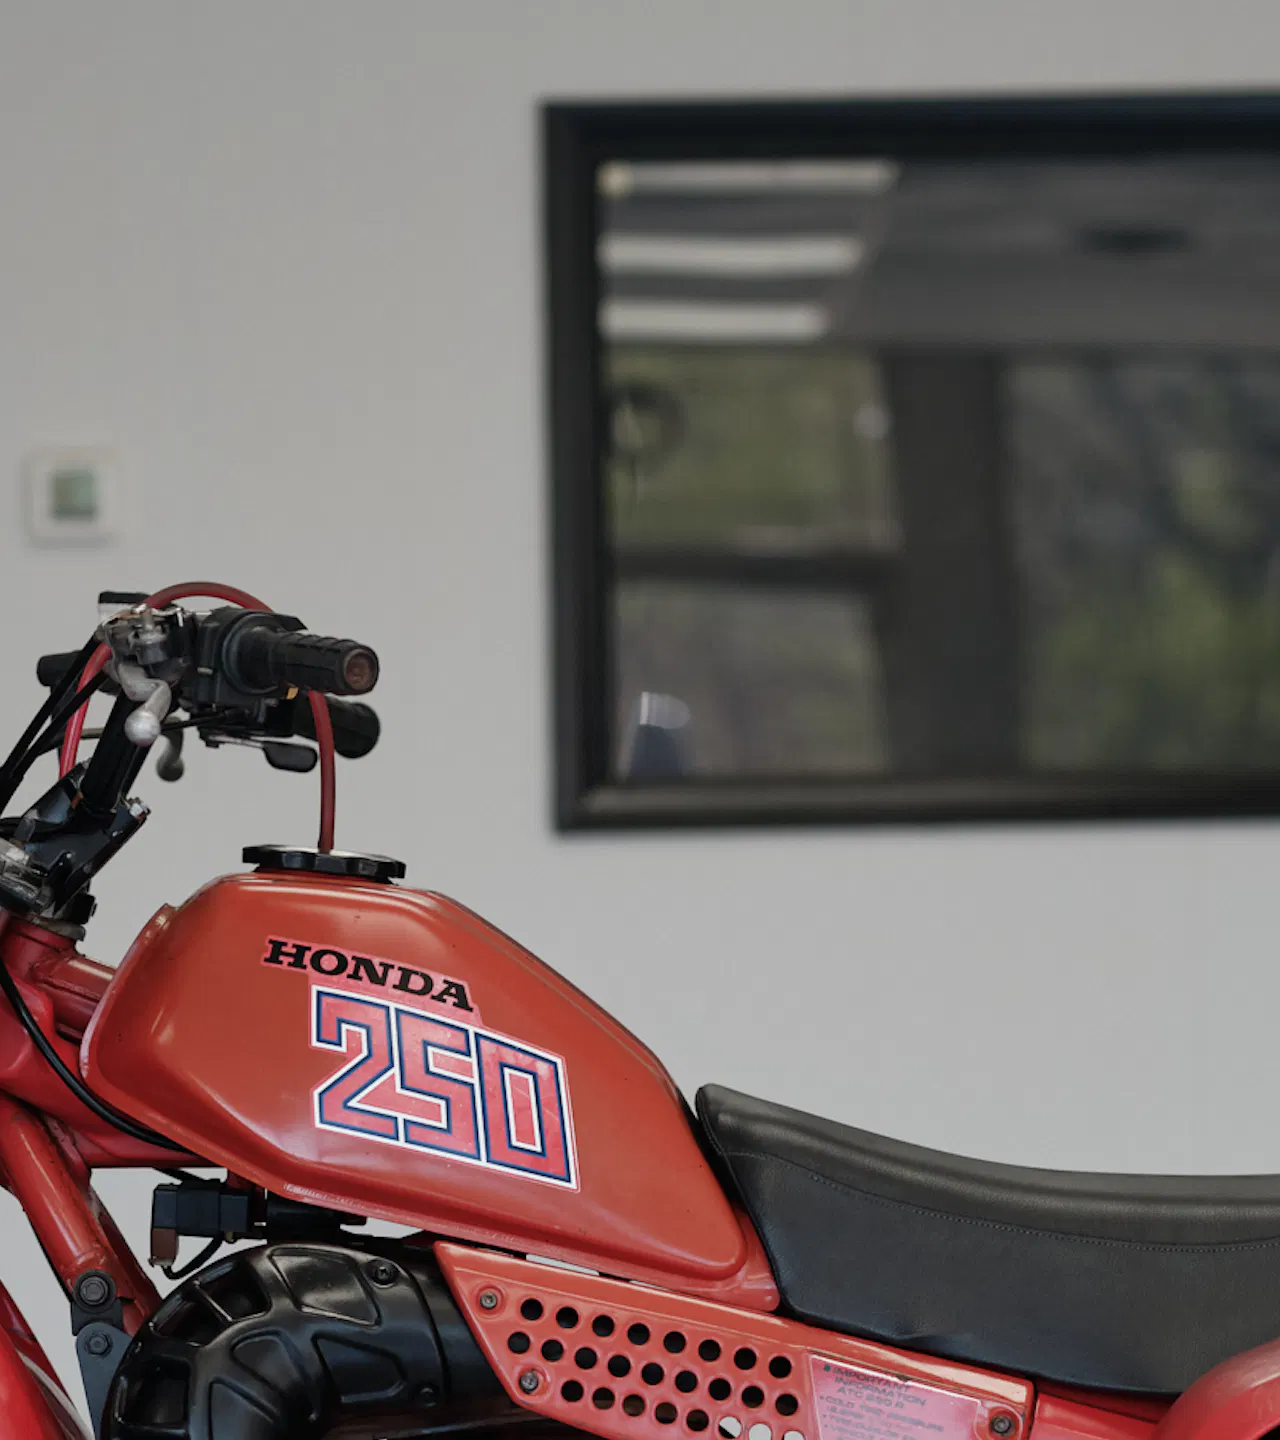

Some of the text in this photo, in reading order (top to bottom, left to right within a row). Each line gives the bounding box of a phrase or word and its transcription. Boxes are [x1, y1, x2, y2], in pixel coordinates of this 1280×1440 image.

[264, 938, 473, 1012] HONDA
[311, 984, 578, 1190] 250
[837, 1385, 863, 1399] ATC
